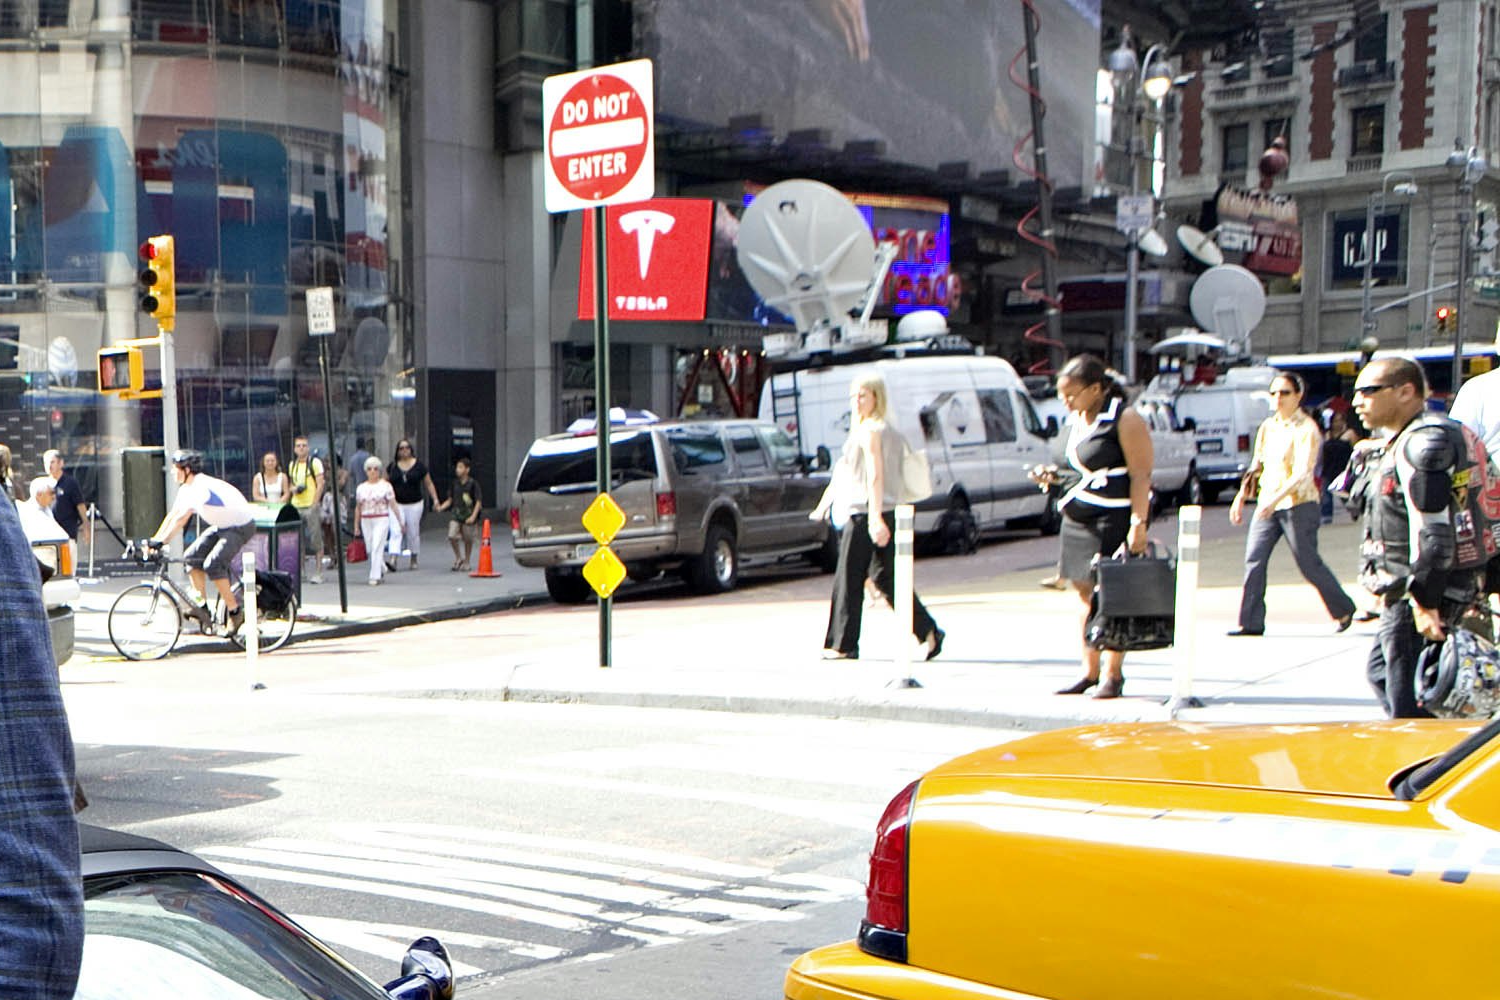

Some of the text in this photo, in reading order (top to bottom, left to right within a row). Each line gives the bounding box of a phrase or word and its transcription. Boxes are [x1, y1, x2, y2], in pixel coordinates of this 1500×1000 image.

[562, 91, 631, 126] DO NOT
[567, 151, 627, 183] ENTER
[615, 295, 668, 311] TESLA
